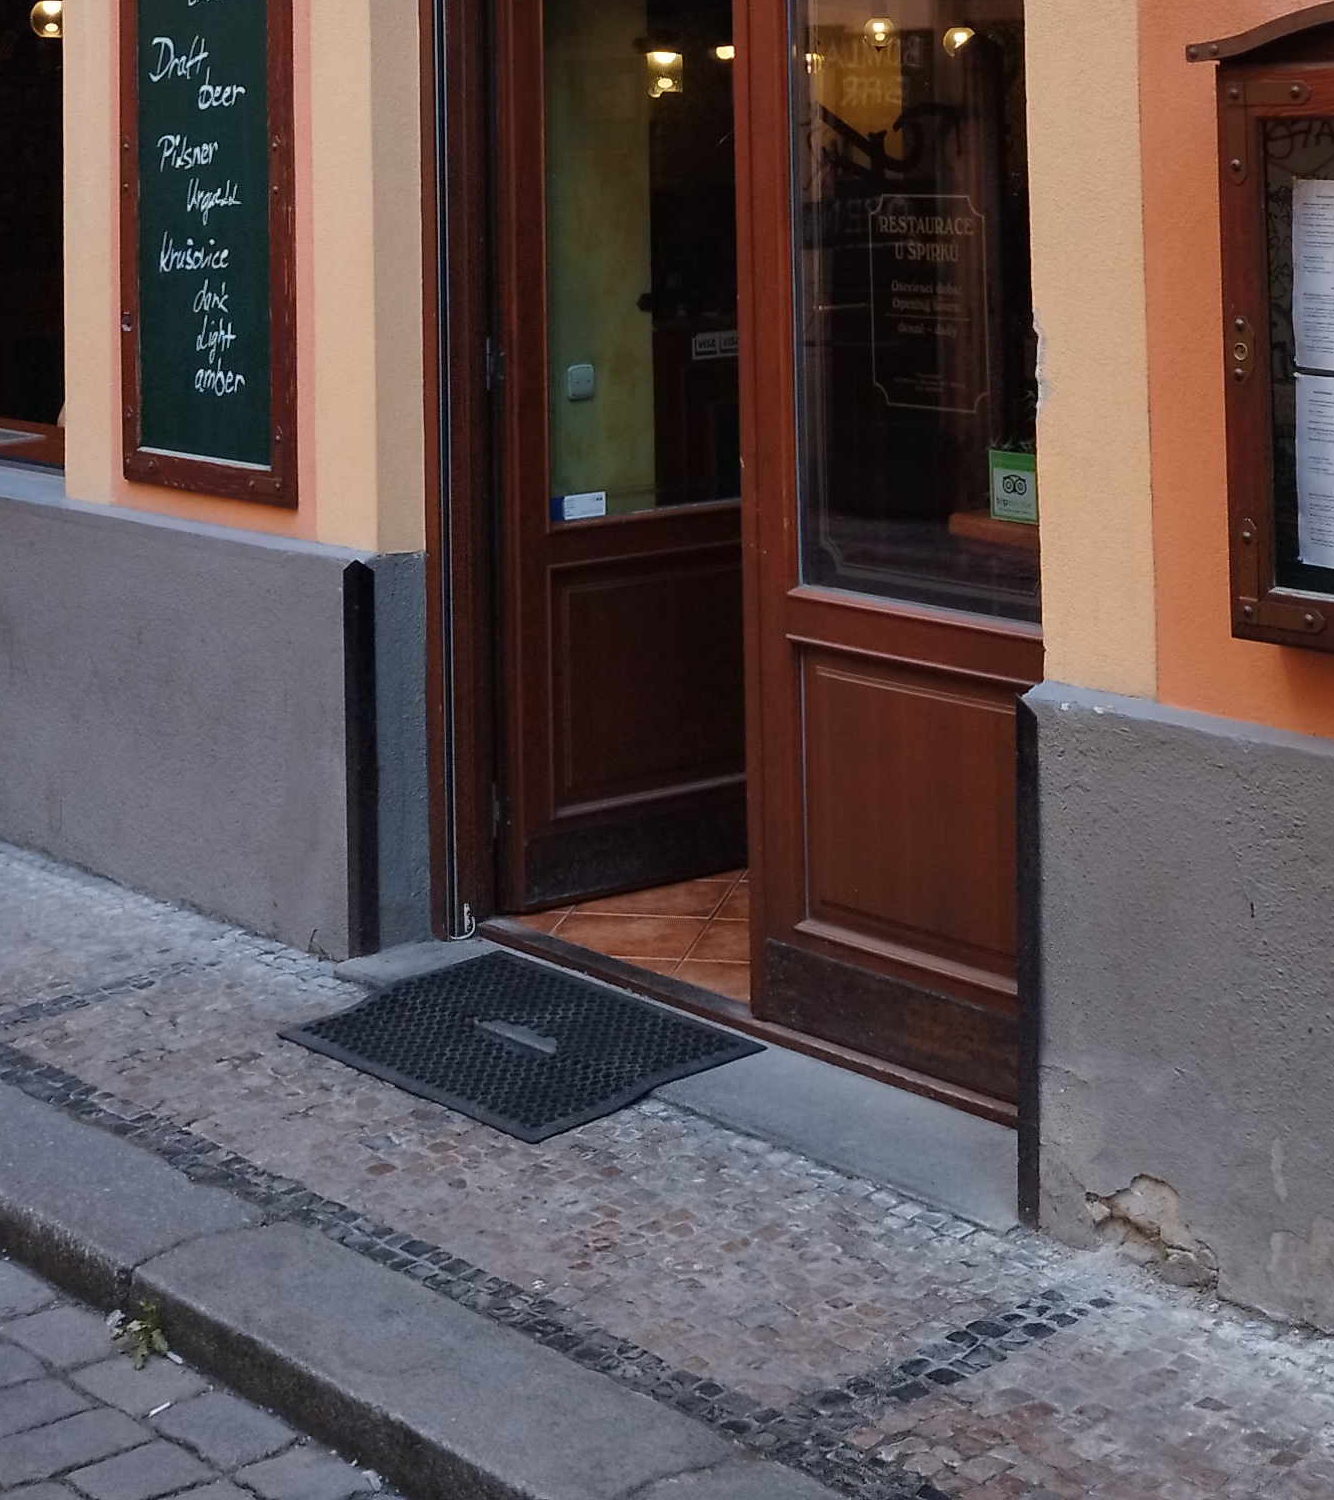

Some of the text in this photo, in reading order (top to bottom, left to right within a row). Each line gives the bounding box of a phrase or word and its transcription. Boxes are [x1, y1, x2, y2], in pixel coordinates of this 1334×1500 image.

[149, 34, 210, 83] Draft
[197, 65, 247, 110] beer
[156, 133, 219, 172] Pilsner
[879, 215, 974, 236] RESTAURACE
[894, 242, 904, 260] U
[193, 278, 230, 313] dark
[892, 296, 931, 313] Opening
[194, 357, 246, 397] amber
